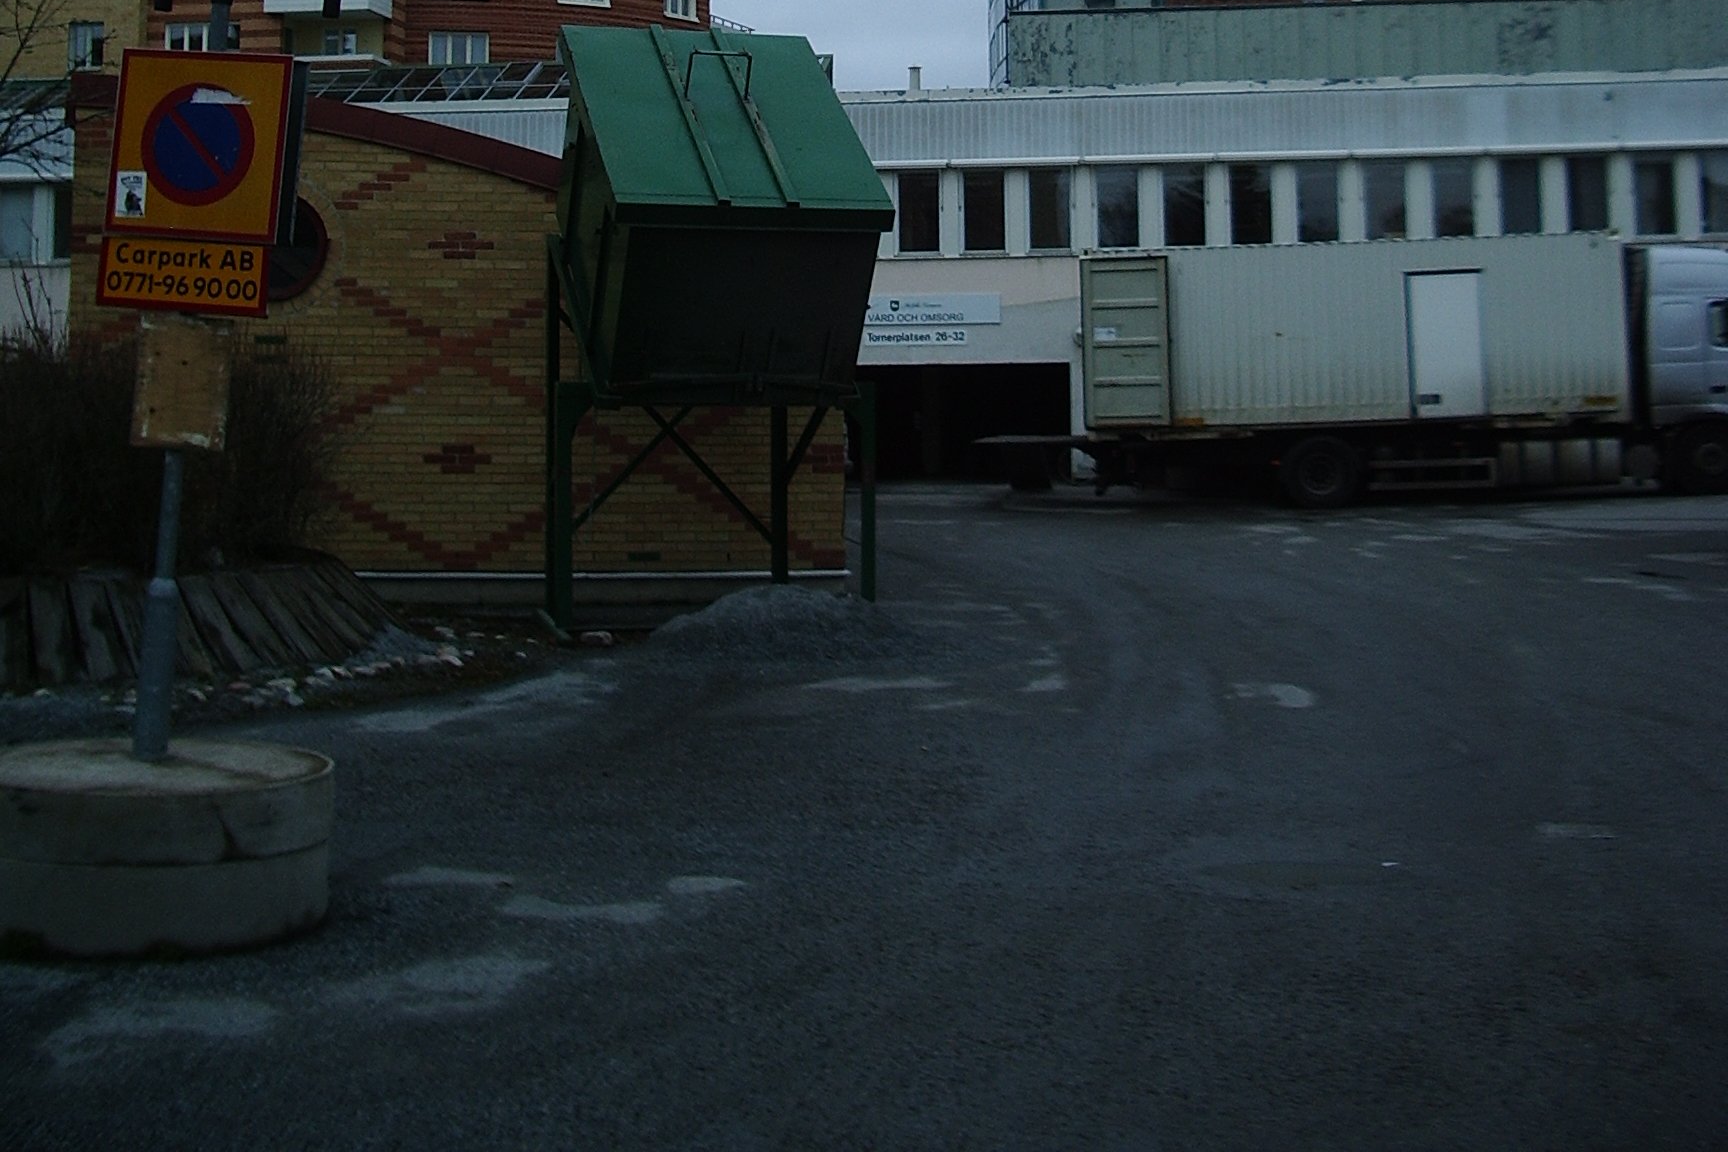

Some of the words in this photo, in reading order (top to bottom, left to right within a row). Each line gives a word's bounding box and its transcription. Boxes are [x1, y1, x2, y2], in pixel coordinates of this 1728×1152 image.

[115, 243, 212, 270] Carpark
[220, 249, 255, 272] AB
[897, 313, 918, 323] OCH
[920, 312, 965, 322] OMSORG
[935, 331, 965, 342] 26-32
